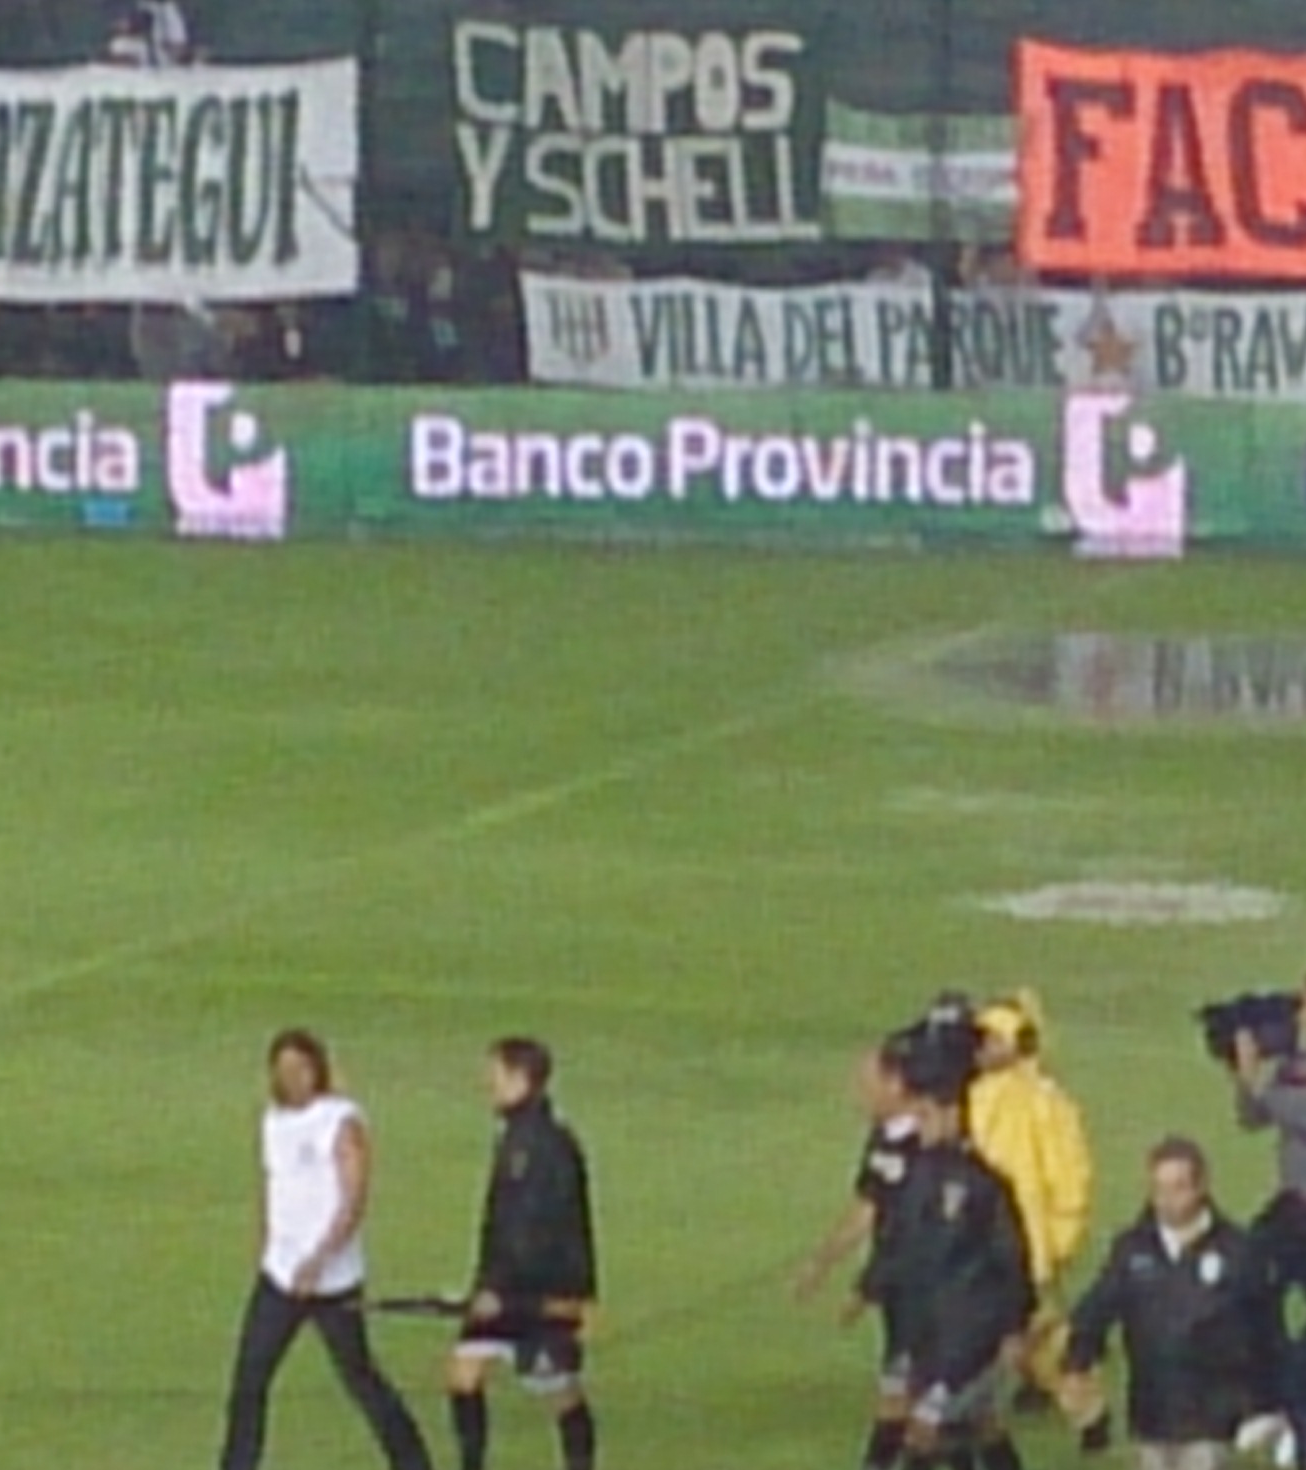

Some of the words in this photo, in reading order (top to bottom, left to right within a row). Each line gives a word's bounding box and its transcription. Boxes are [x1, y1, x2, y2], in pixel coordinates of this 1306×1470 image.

[454, 21, 802, 133] CAMPOS
[456, 122, 512, 230] Y
[525, 133, 821, 242] SCHELL
[629, 293, 766, 380] VILLA
[783, 298, 864, 383] DEL
[410, 415, 654, 500] Banco
[668, 417, 1034, 503] Provincia
